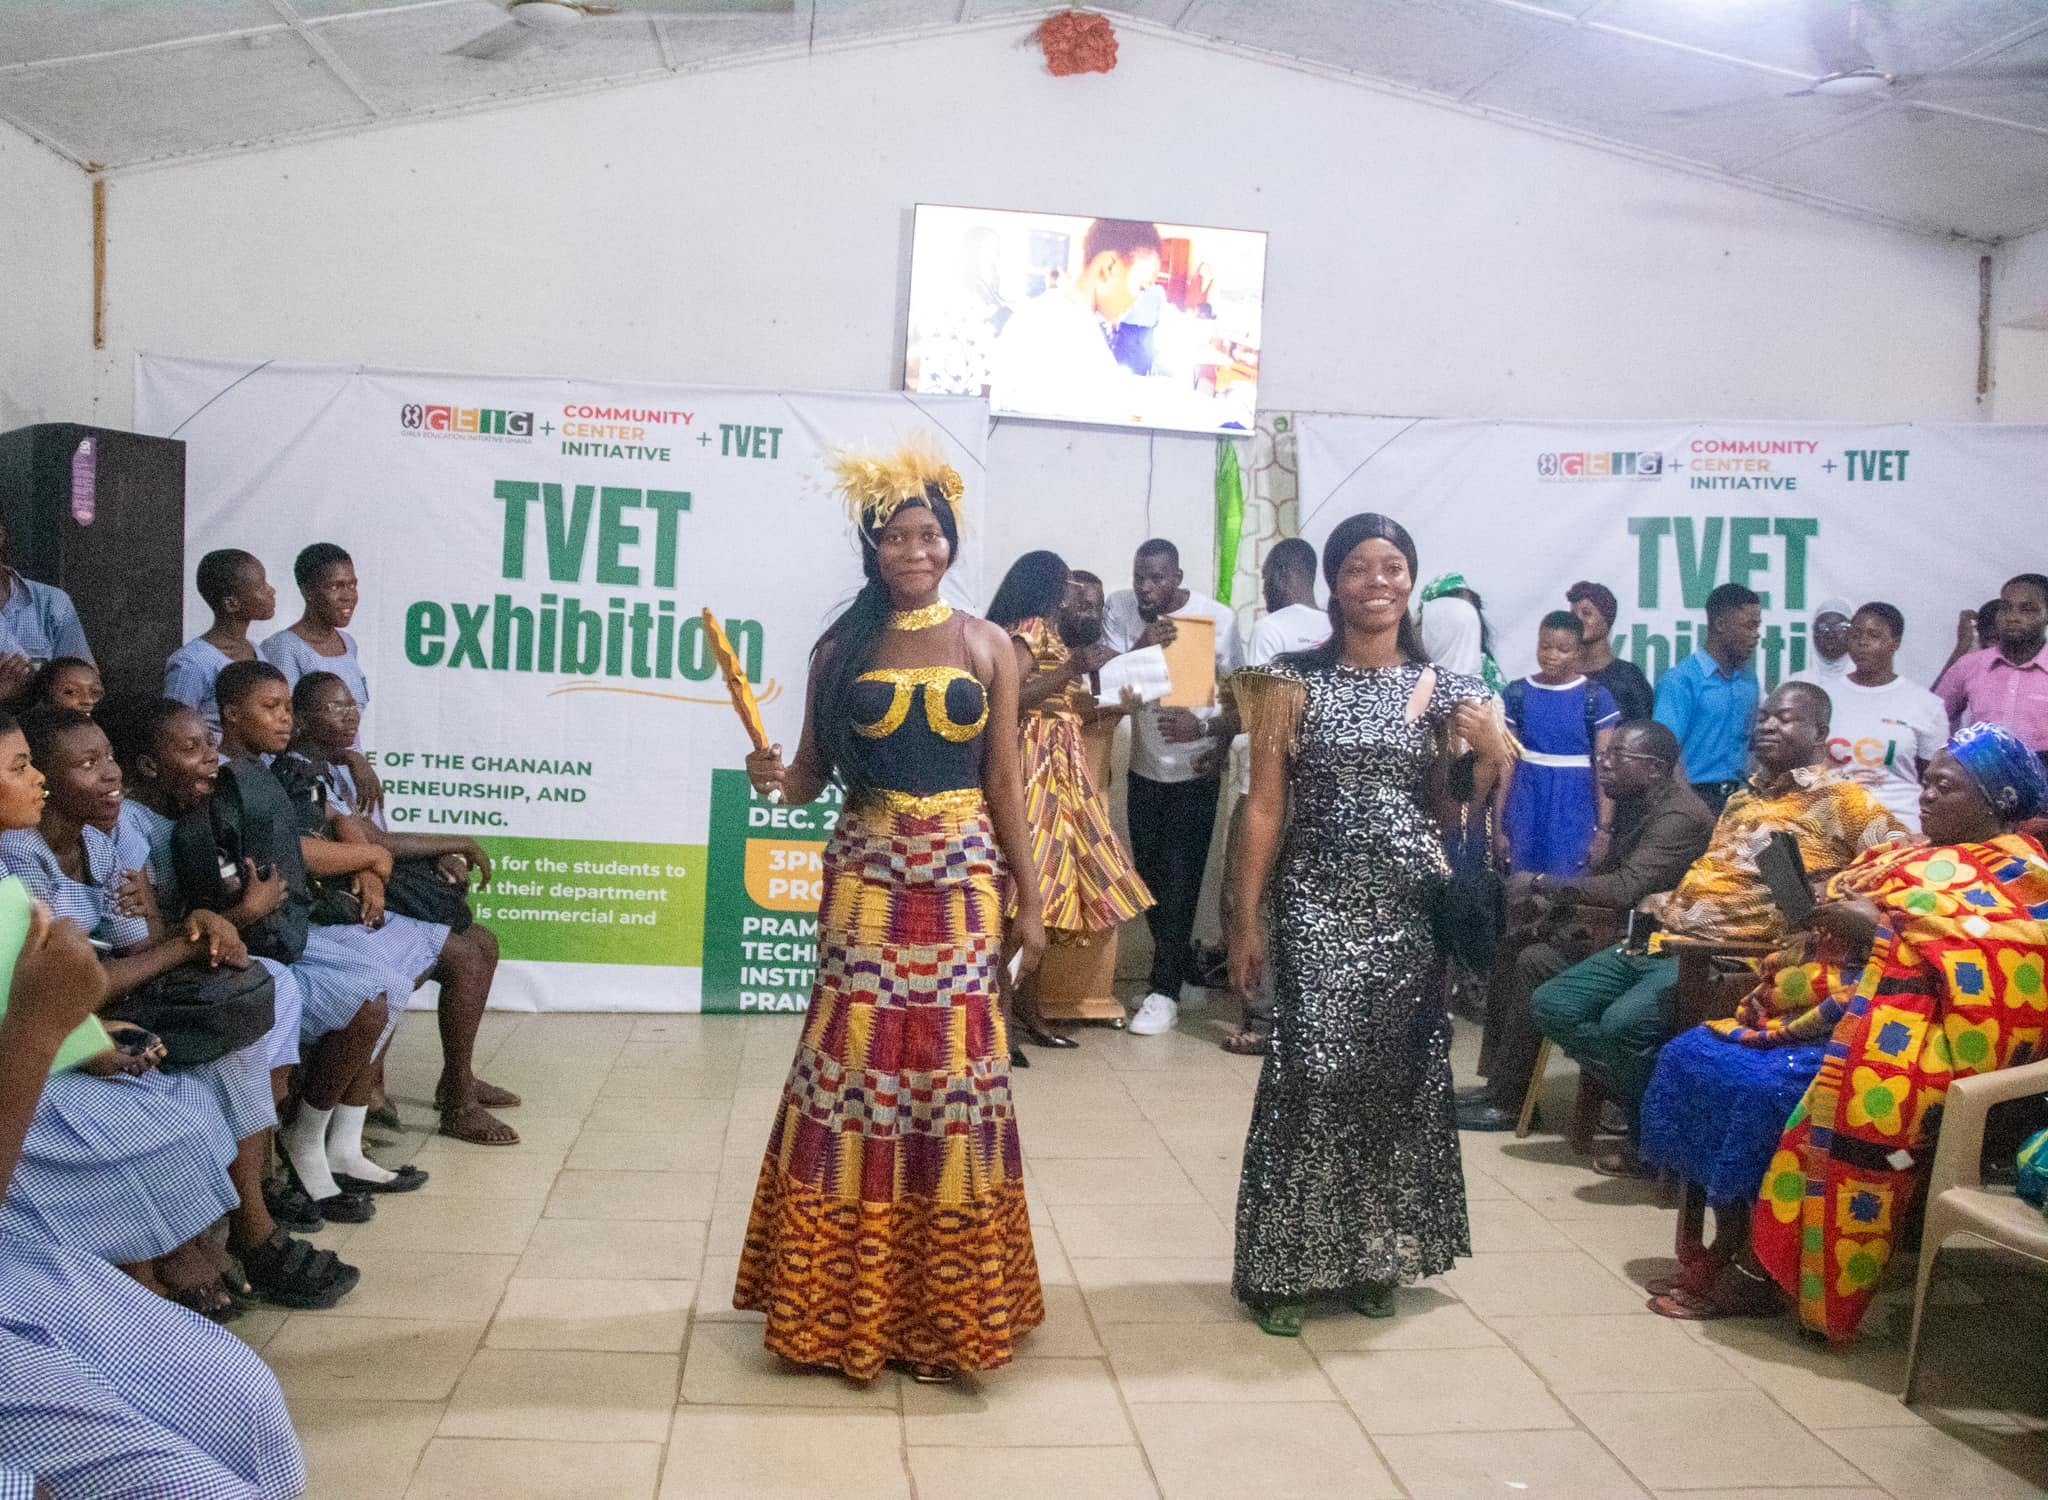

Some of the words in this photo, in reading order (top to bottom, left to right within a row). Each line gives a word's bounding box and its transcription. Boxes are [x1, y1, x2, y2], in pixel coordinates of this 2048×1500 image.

[563, 405, 694, 425] COMMUNITY
[562, 422, 646, 441] CENTER
[719, 423, 783, 459] TVET
[561, 441, 671, 462] INITIATIVE
[1690, 440, 1819, 454] COMMUNITY
[1690, 458, 1771, 472] CENTER
[1844, 450, 1910, 481] TVET
[1690, 477, 1797, 490] INITIATIVE
[494, 479, 692, 588] TVET
[1628, 517, 1819, 610] TVET
[405, 593, 764, 685] exhibition
[1826, 737, 1896, 767] CCI
[384, 752, 415, 767] OF
[421, 754, 464, 770] THE
[471, 756, 592, 776] GHANAIAN
[382, 779, 530, 803] RENEURSHIP,
[537, 787, 586, 802] AND
[391, 807, 421, 822] OF
[428, 809, 508, 826] LIVING.
[749, 807, 815, 829] DEC.
[822, 810, 839, 830] 2
[501, 855, 529, 871] for
[535, 858, 568, 873] the
[573, 860, 660, 876] students
[666, 863, 686, 878] to
[497, 881, 544, 896] their
[549, 882, 667, 901] department
[476, 903, 491, 919] is
[497, 908, 614, 924] commercial
[619, 911, 656, 925] and
[743, 917, 818, 937] PRAM
[741, 941, 817, 962] TECH
[740, 991, 810, 1012] PRAM
